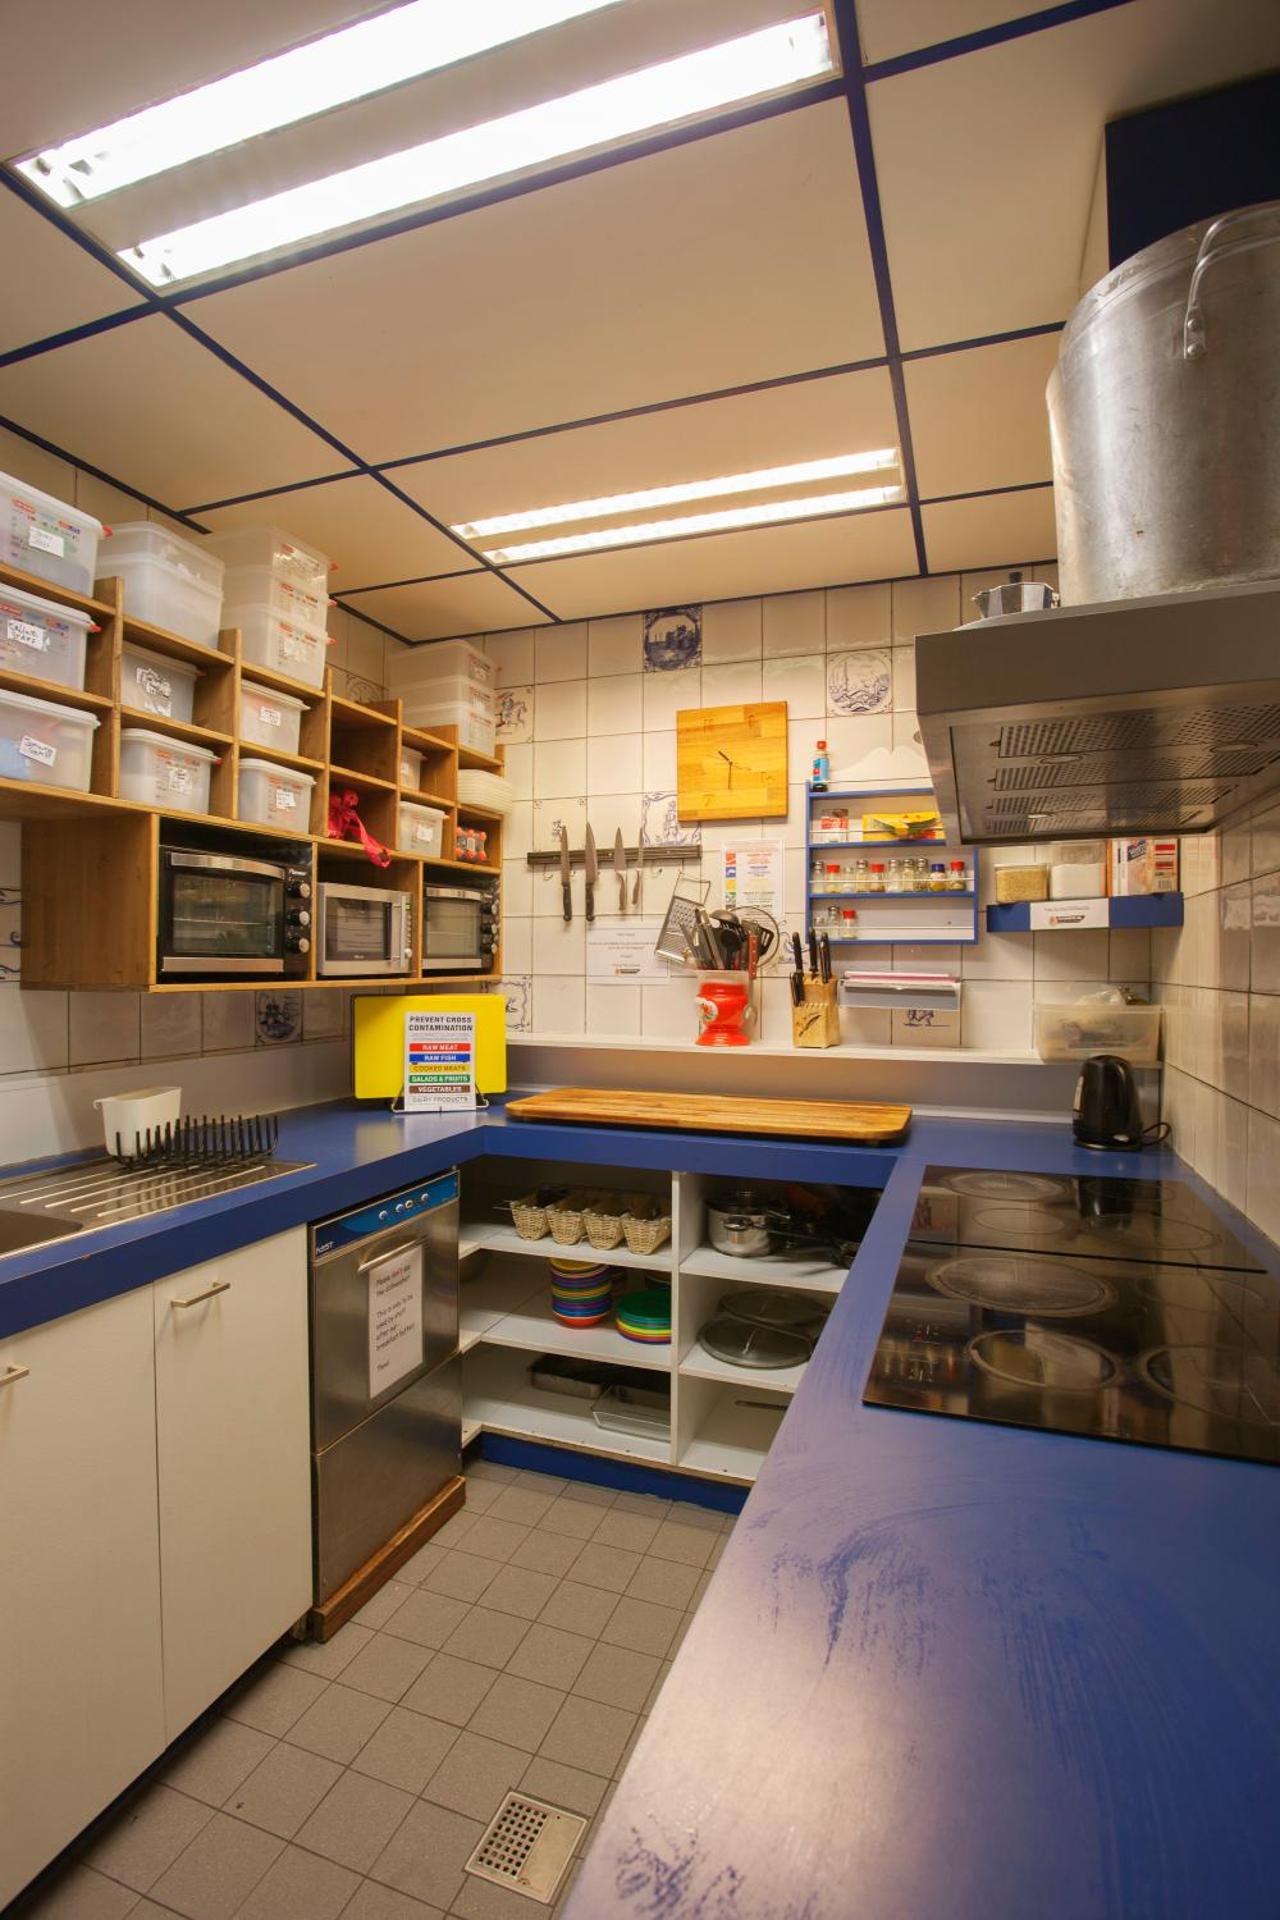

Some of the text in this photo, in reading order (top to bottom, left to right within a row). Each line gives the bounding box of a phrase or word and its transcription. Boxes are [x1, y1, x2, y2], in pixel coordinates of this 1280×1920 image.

[409, 1015, 472, 1024] PREVENT CROSS
[409, 1024, 473, 1032] CONTAMINATION
